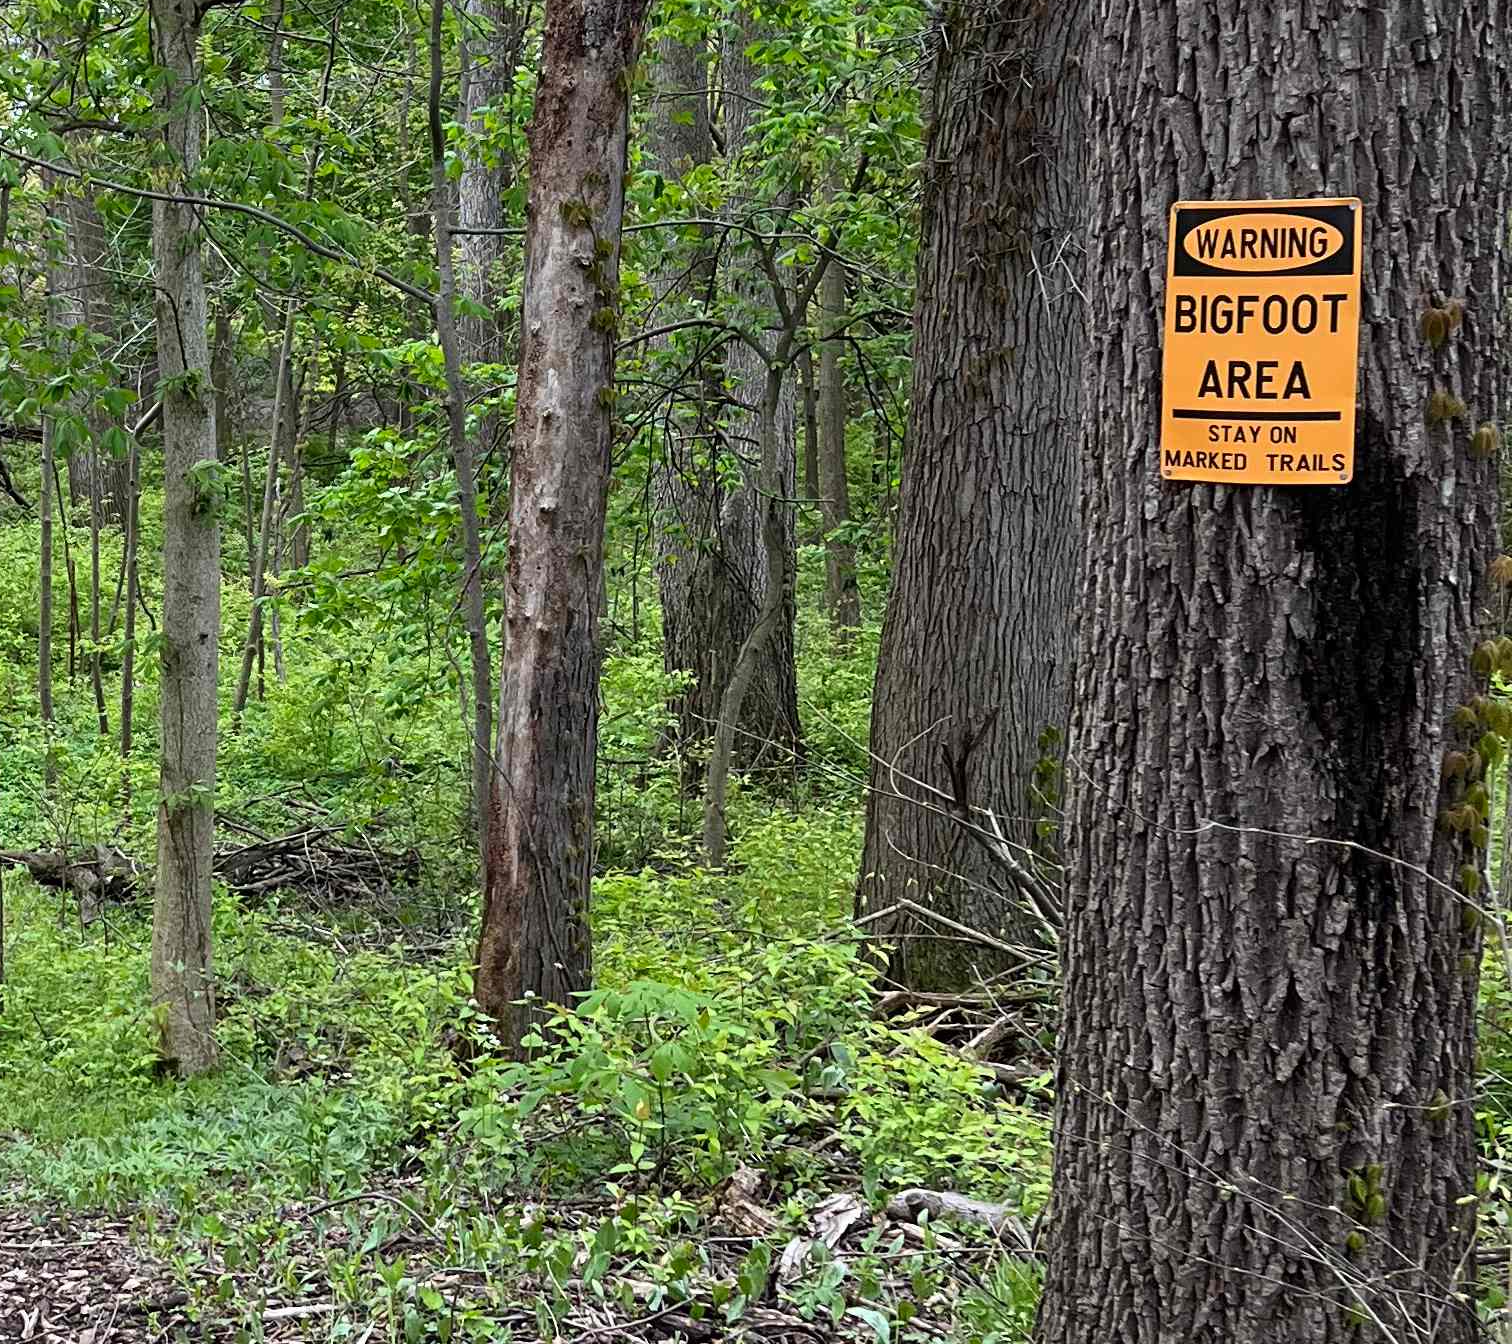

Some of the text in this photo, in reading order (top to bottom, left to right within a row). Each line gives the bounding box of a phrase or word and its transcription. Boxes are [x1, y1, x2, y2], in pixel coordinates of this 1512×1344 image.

[1196, 227, 1328, 259] WARNING
[1175, 294, 1348, 334] BIGFOOT
[1198, 360, 1311, 399] AREA
[1208, 425, 1297, 443] STAY ON
[1164, 450, 1345, 471] MARKED TRAILS
